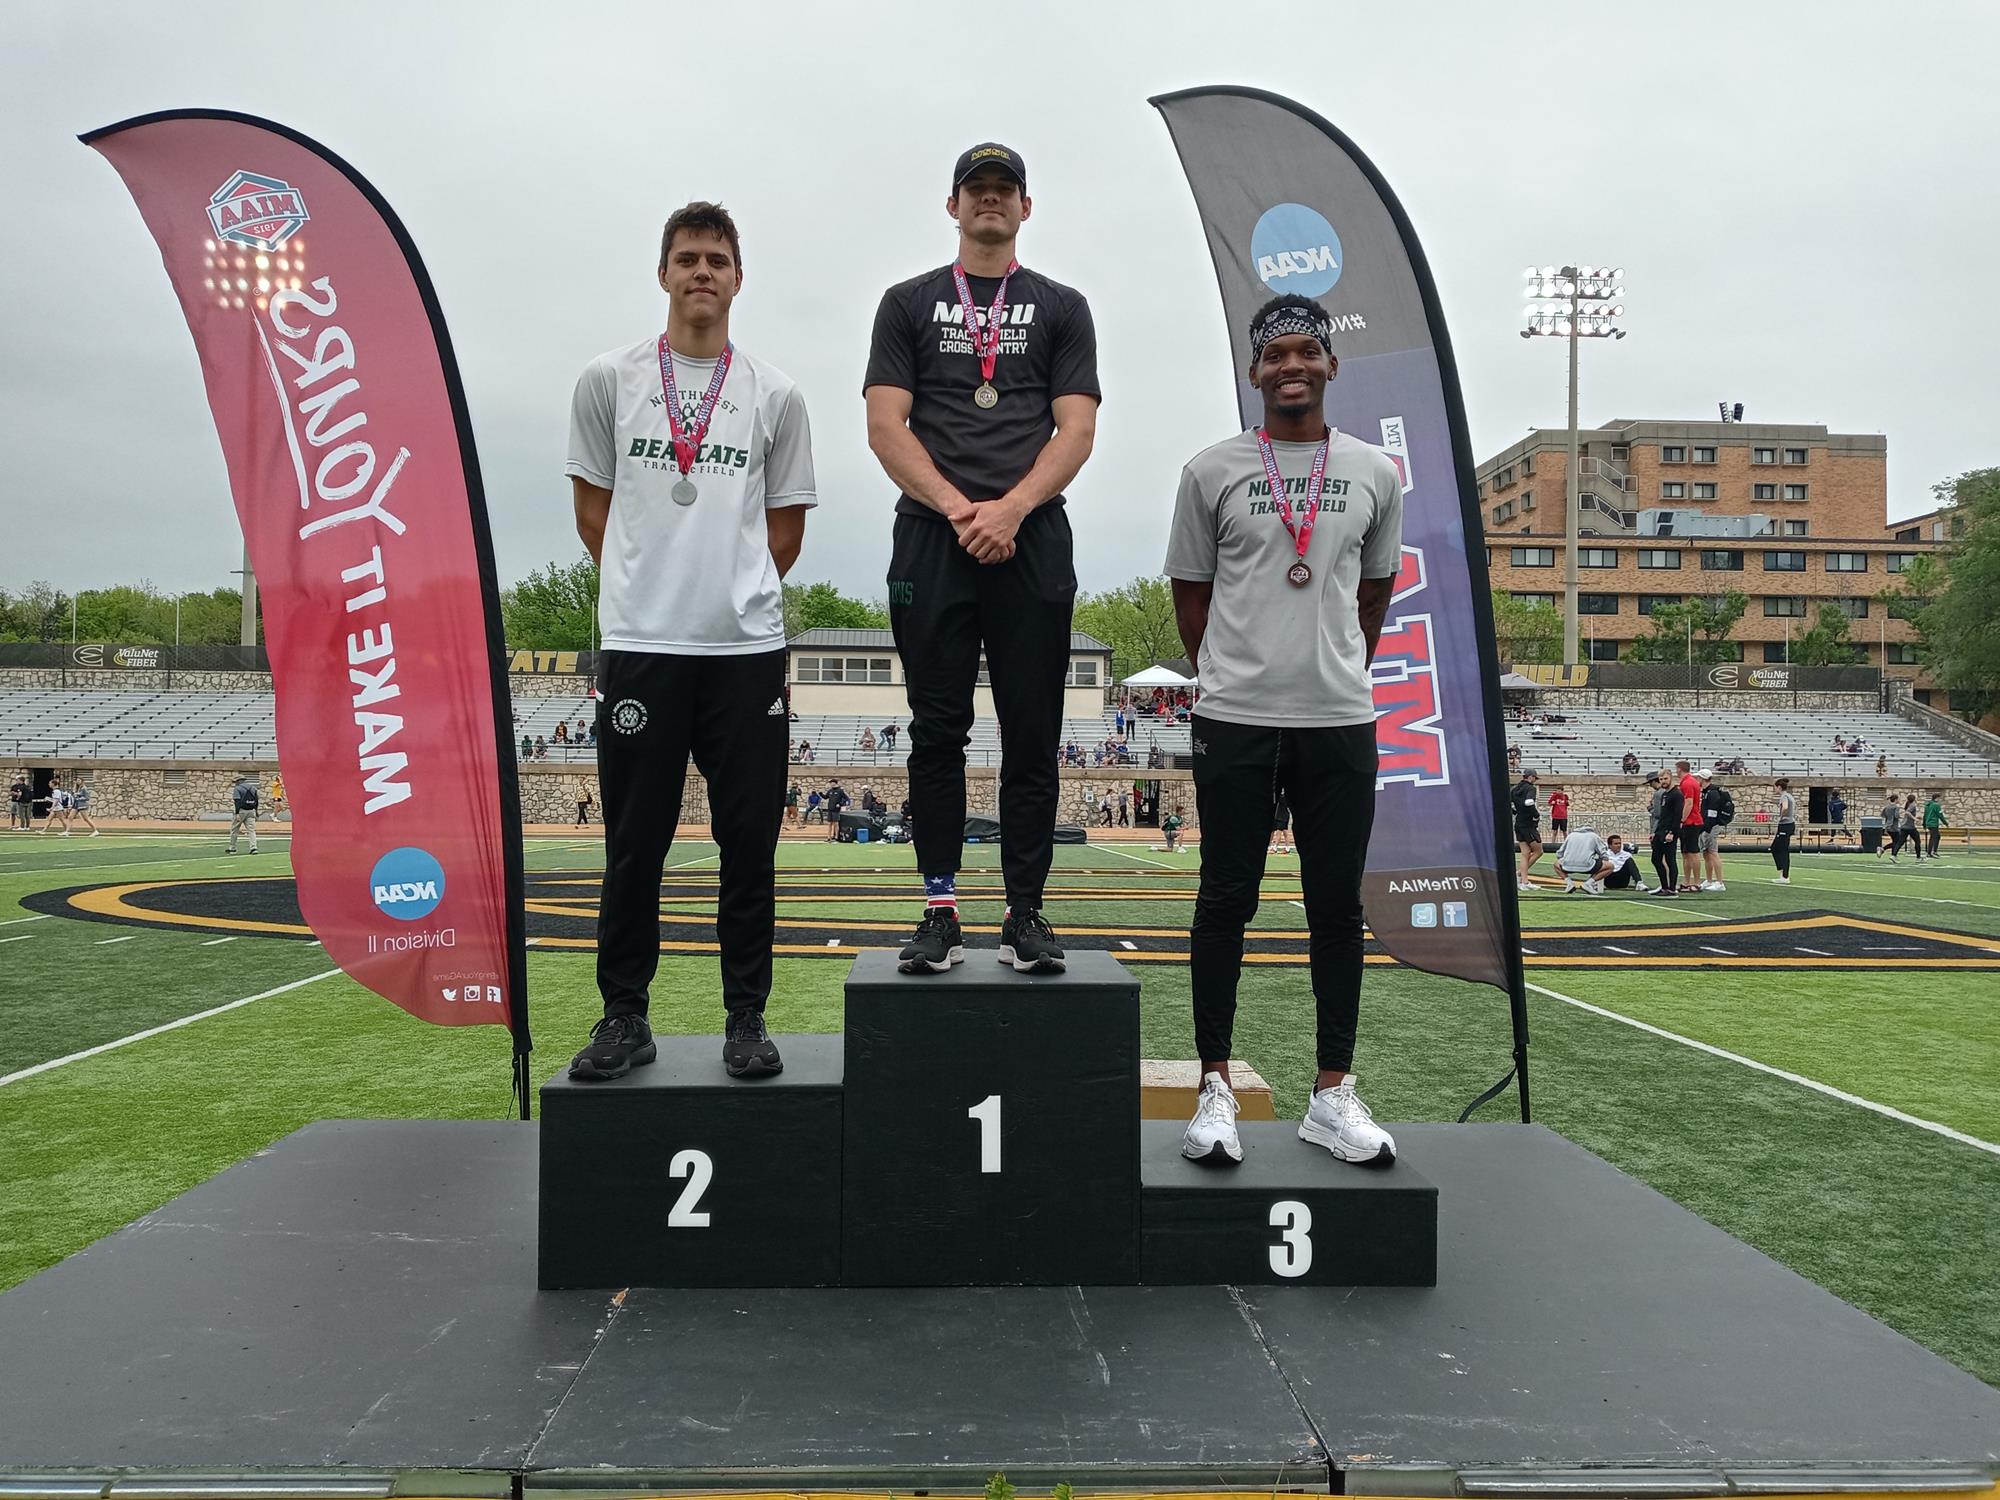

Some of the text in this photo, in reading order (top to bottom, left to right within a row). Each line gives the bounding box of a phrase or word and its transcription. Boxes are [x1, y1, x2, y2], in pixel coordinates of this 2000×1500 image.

[942, 327, 975, 342] TRAC
[998, 328, 1027, 341] IELD
[940, 341, 974, 355] CROSS
[628, 438, 748, 468] BEACATS
[643, 460, 682, 474] TRAC
[700, 465, 735, 477] FIELD
[1248, 477, 1351, 497] NOTHEST
[1317, 499, 1346, 513] IELD
[119, 648, 159, 658] ValuNet
[127, 659, 157, 667] FIBER
[1753, 670, 1789, 679] ValuNet
[1760, 680, 1788, 688] FIBER
[968, 1094, 1002, 1173] 1
[667, 1149, 713, 1227] 2
[1268, 1200, 1313, 1278] 3
